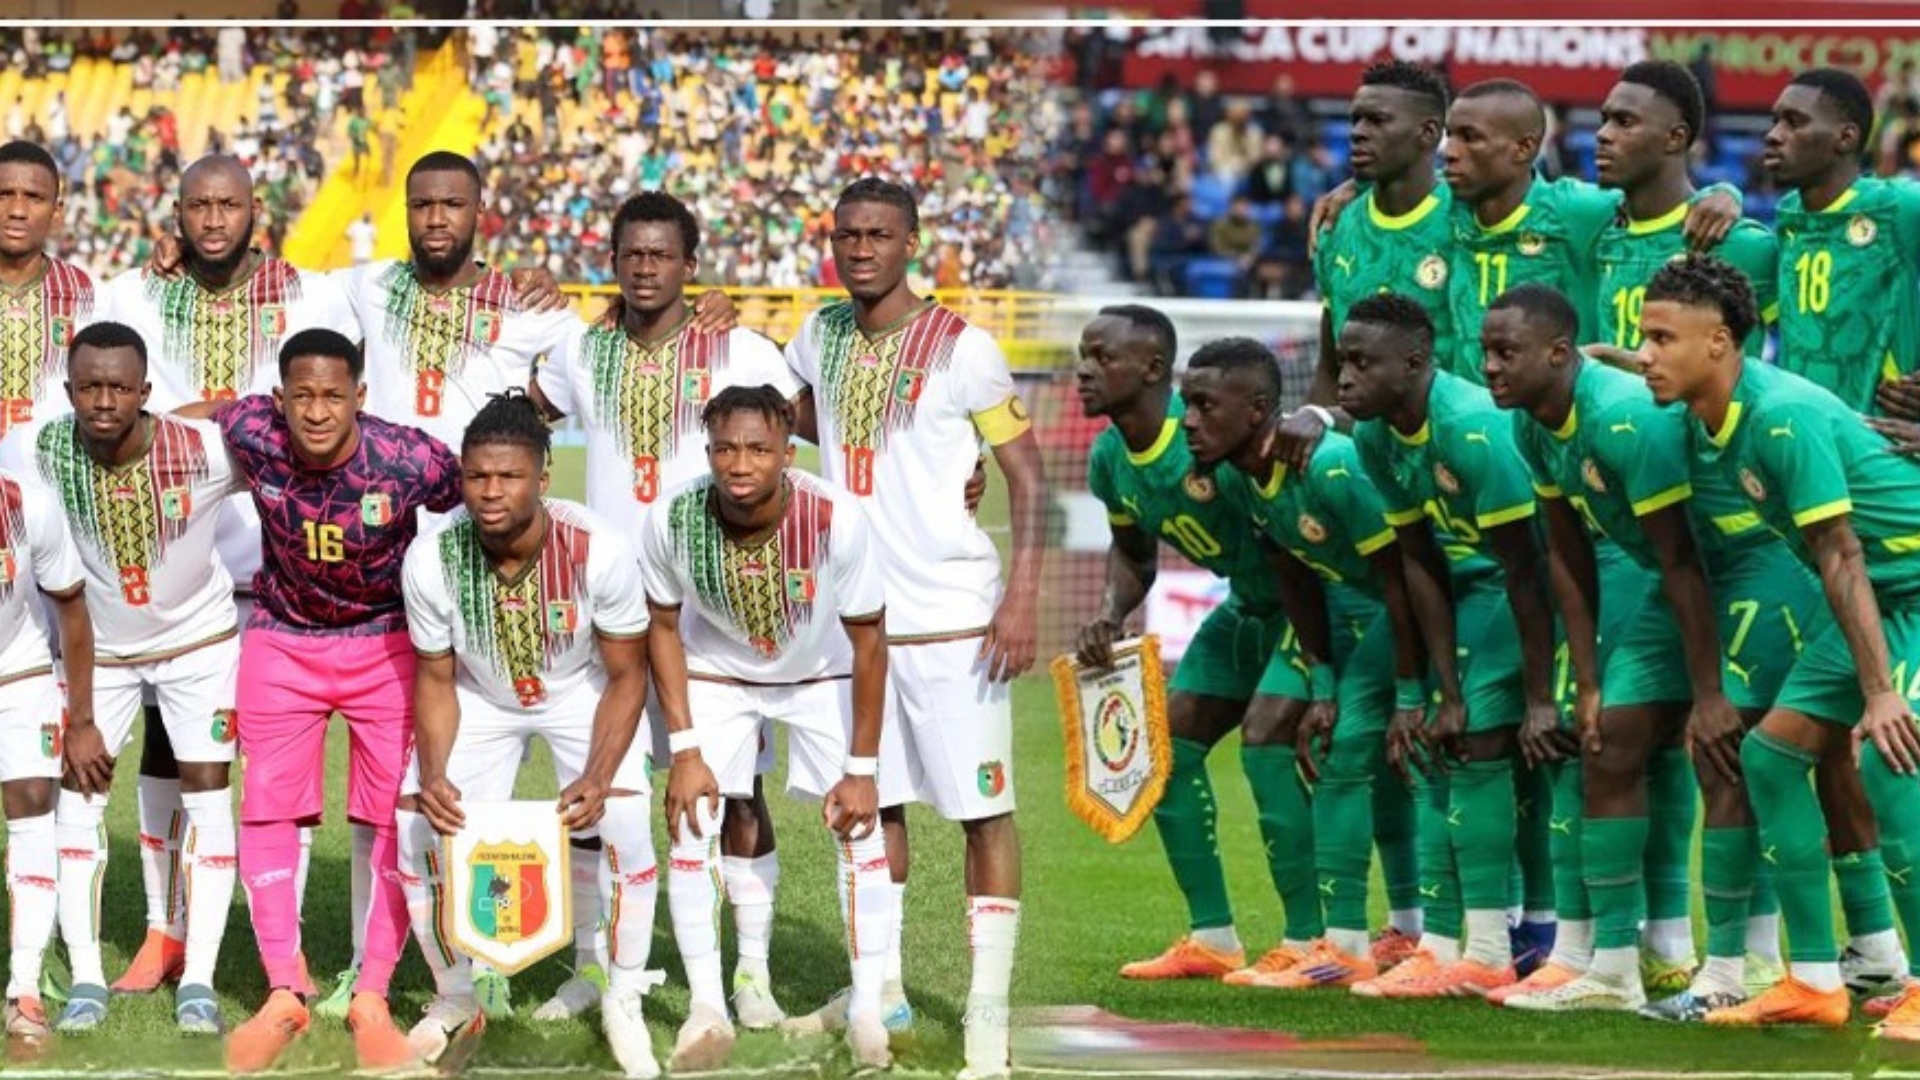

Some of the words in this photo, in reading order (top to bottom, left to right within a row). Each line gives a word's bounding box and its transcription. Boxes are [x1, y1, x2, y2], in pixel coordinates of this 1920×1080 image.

[1297, 21, 1387, 63] CUP
[1391, 22, 1451, 63] OF
[1453, 22, 1648, 68] NATIONS
[1652, 32, 1878, 77] MOROCCO
[1475, 252, 1507, 306] 11
[1795, 251, 1832, 314] 18
[1612, 285, 1646, 349] 19
[417, 368, 443, 417] 6
[633, 455, 658, 503] 3
[843, 444, 874, 497] 10
[303, 520, 344, 561] 16
[1162, 515, 1220, 559] 10
[120, 564, 150, 606] 2
[1728, 601, 1758, 656] 7
